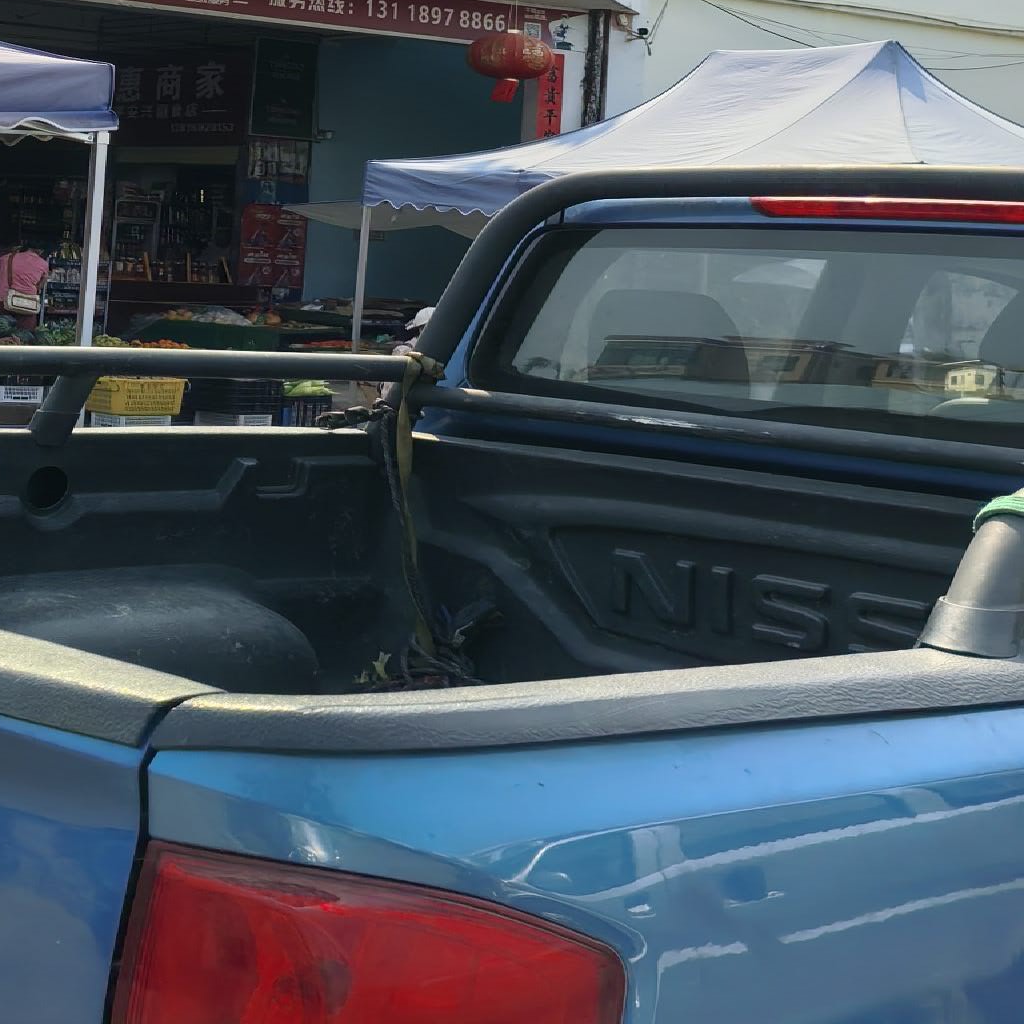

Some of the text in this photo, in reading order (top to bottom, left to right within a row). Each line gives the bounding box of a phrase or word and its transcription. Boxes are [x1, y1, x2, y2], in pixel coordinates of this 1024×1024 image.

[365, 0, 399, 21] 131
[408, 3, 454, 27] 1897
[459, 9, 506, 33] 8866
